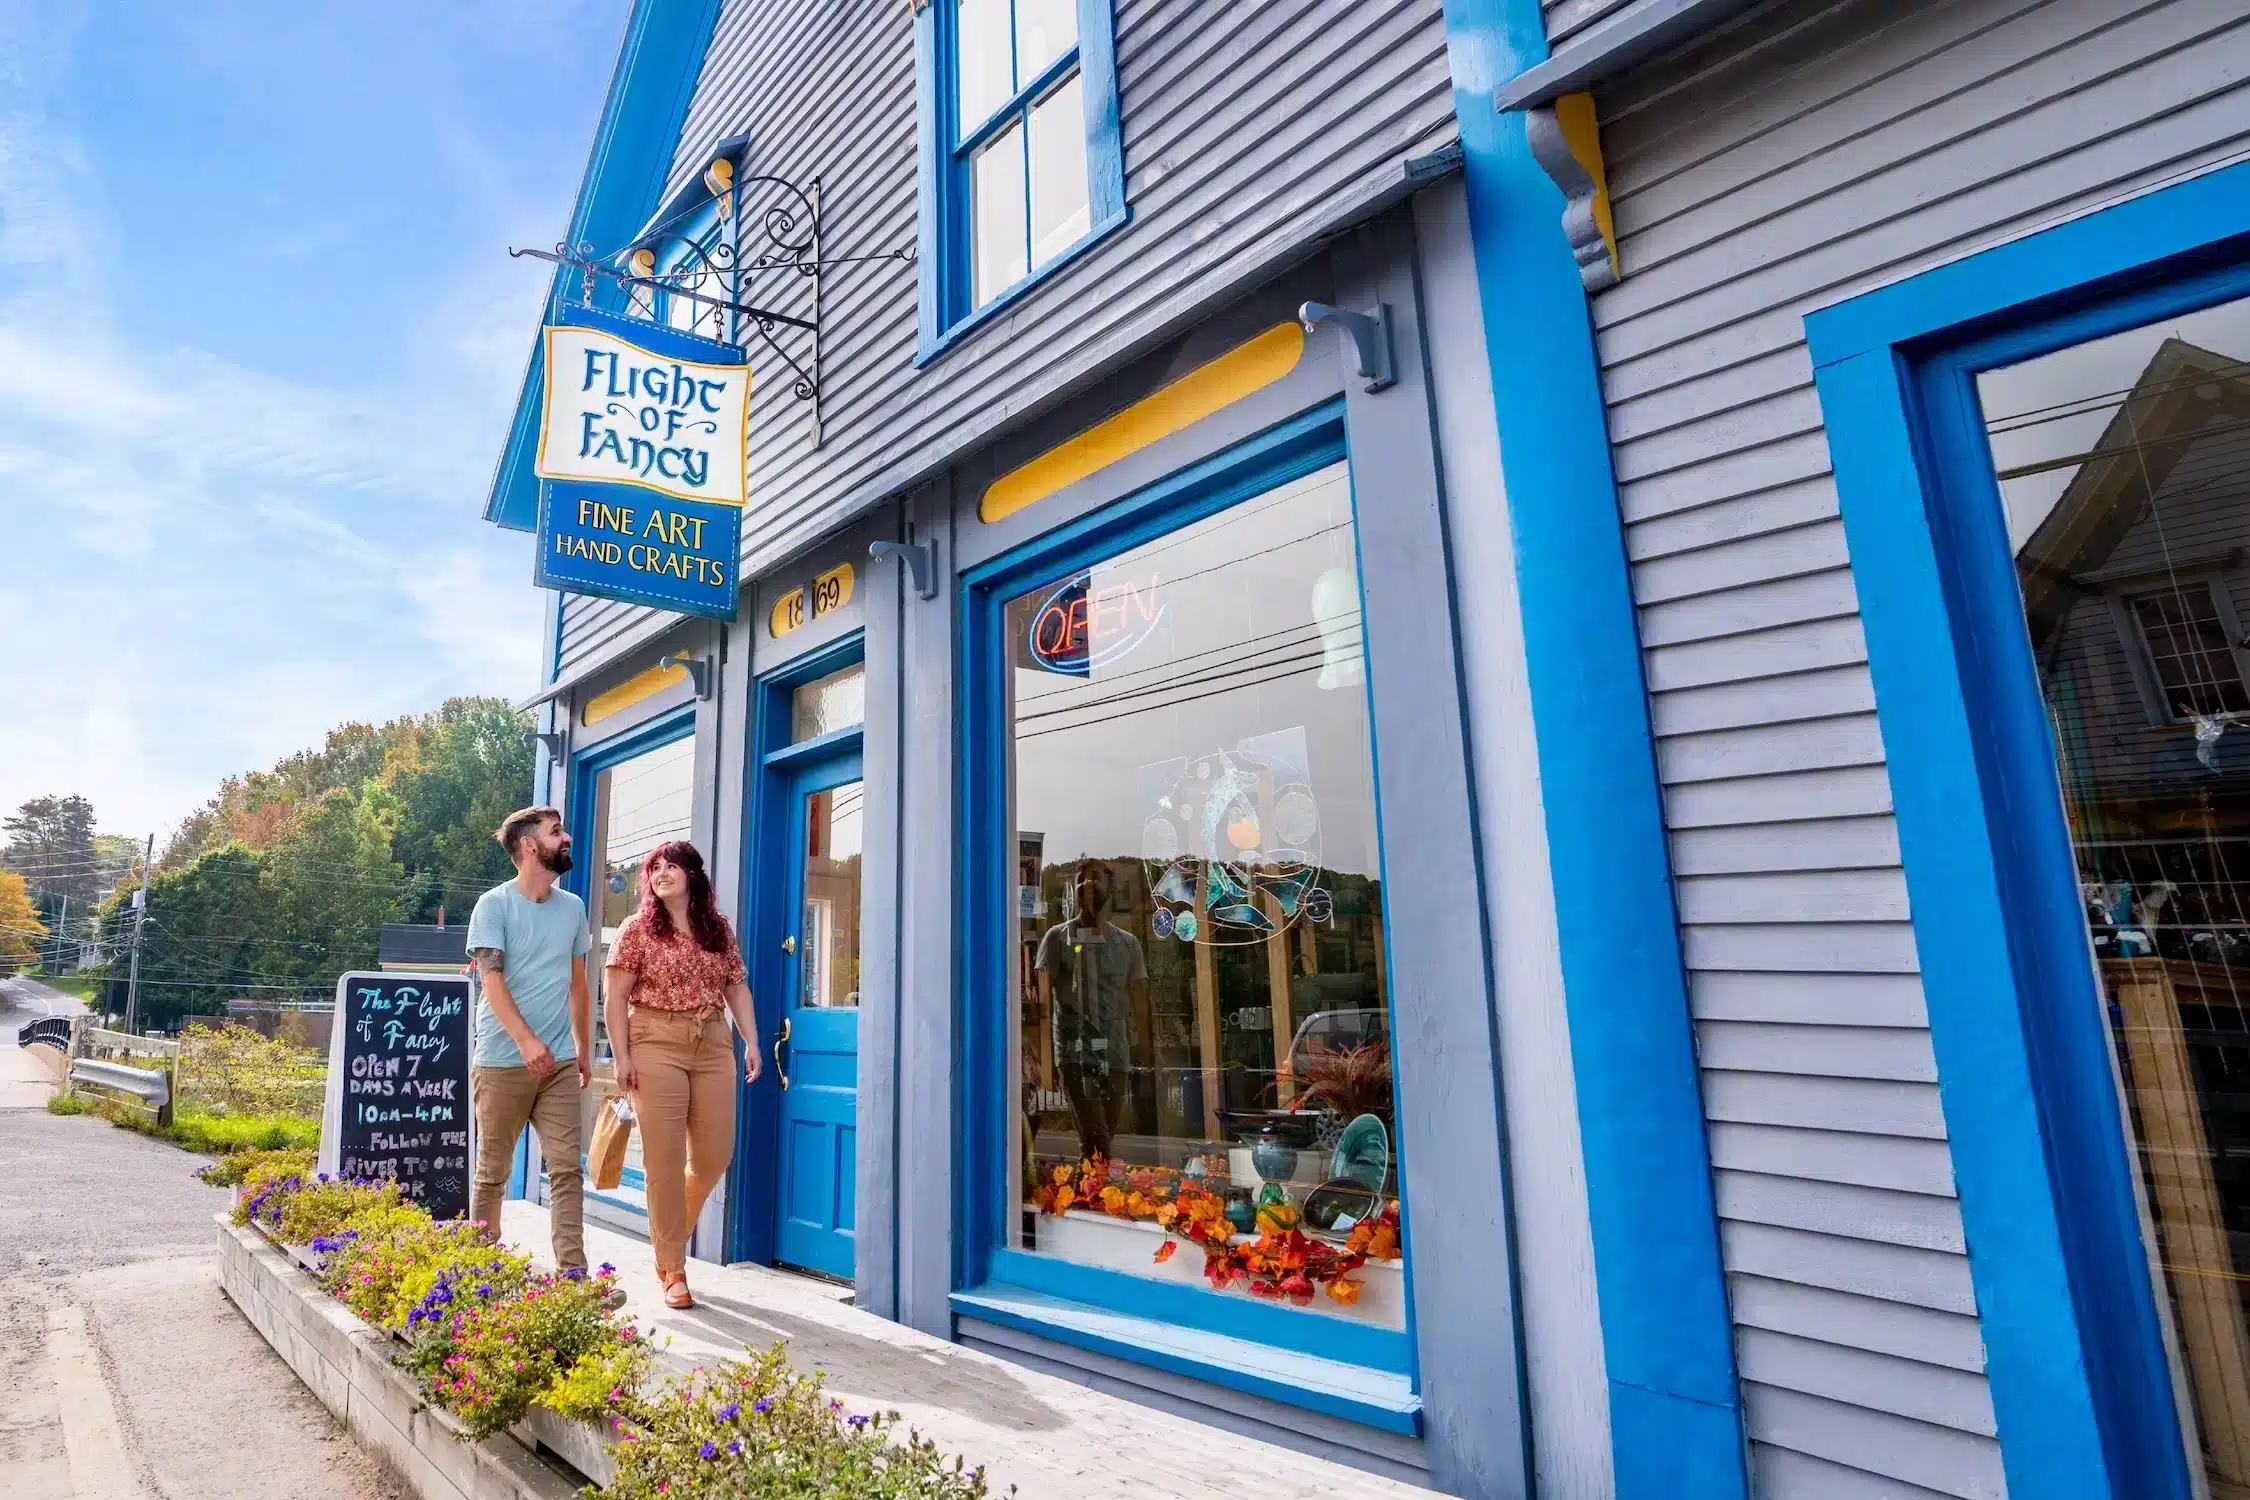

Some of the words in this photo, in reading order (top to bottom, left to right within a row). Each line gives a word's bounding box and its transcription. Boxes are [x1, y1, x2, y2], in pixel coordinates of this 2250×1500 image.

[639, 405, 688, 440] OF
[577, 499, 635, 535] FINE
[643, 508, 709, 550] ART
[556, 533, 622, 565] HAND
[628, 544, 724, 586] CRAFTS
[1035, 572, 1161, 655] OPEN
[356, 987, 392, 1010] The
[394, 986, 462, 1031] Flight
[356, 1013, 373, 1042] of
[382, 1019, 450, 1062] Fancy
[352, 1053, 401, 1078] OPEN
[405, 1054, 423, 1078] 7
[349, 1079, 396, 1097] DAYS
[400, 1081, 412, 1096] A
[412, 1078, 458, 1100] WEEK
[441, 1131, 467, 1147] THE
[402, 1157, 429, 1176] TO
[433, 1155, 465, 1170] OUR
